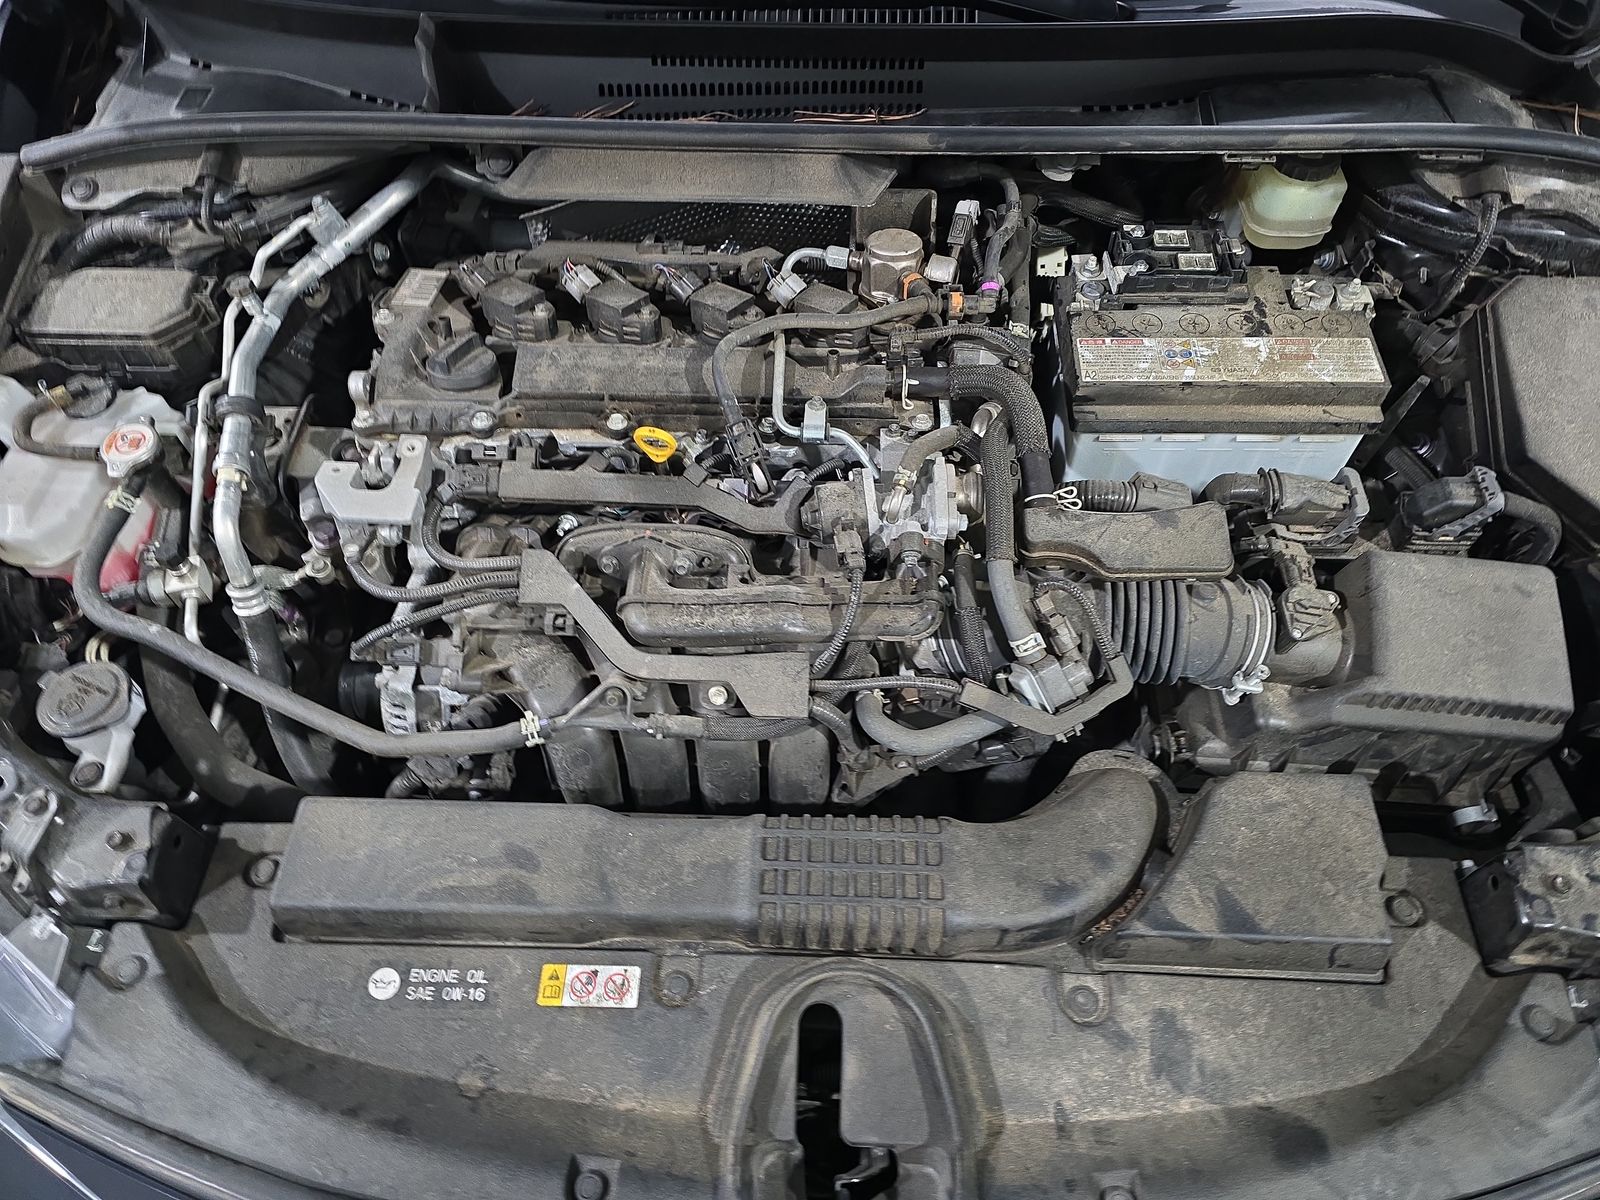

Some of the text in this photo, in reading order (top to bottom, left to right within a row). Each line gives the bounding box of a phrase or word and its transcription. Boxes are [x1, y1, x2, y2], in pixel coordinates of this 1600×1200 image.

[1084, 370, 1098, 380] A2
[408, 968, 489, 984] ENGINE OIL
[405, 986, 487, 1002] SAE 0W-16
